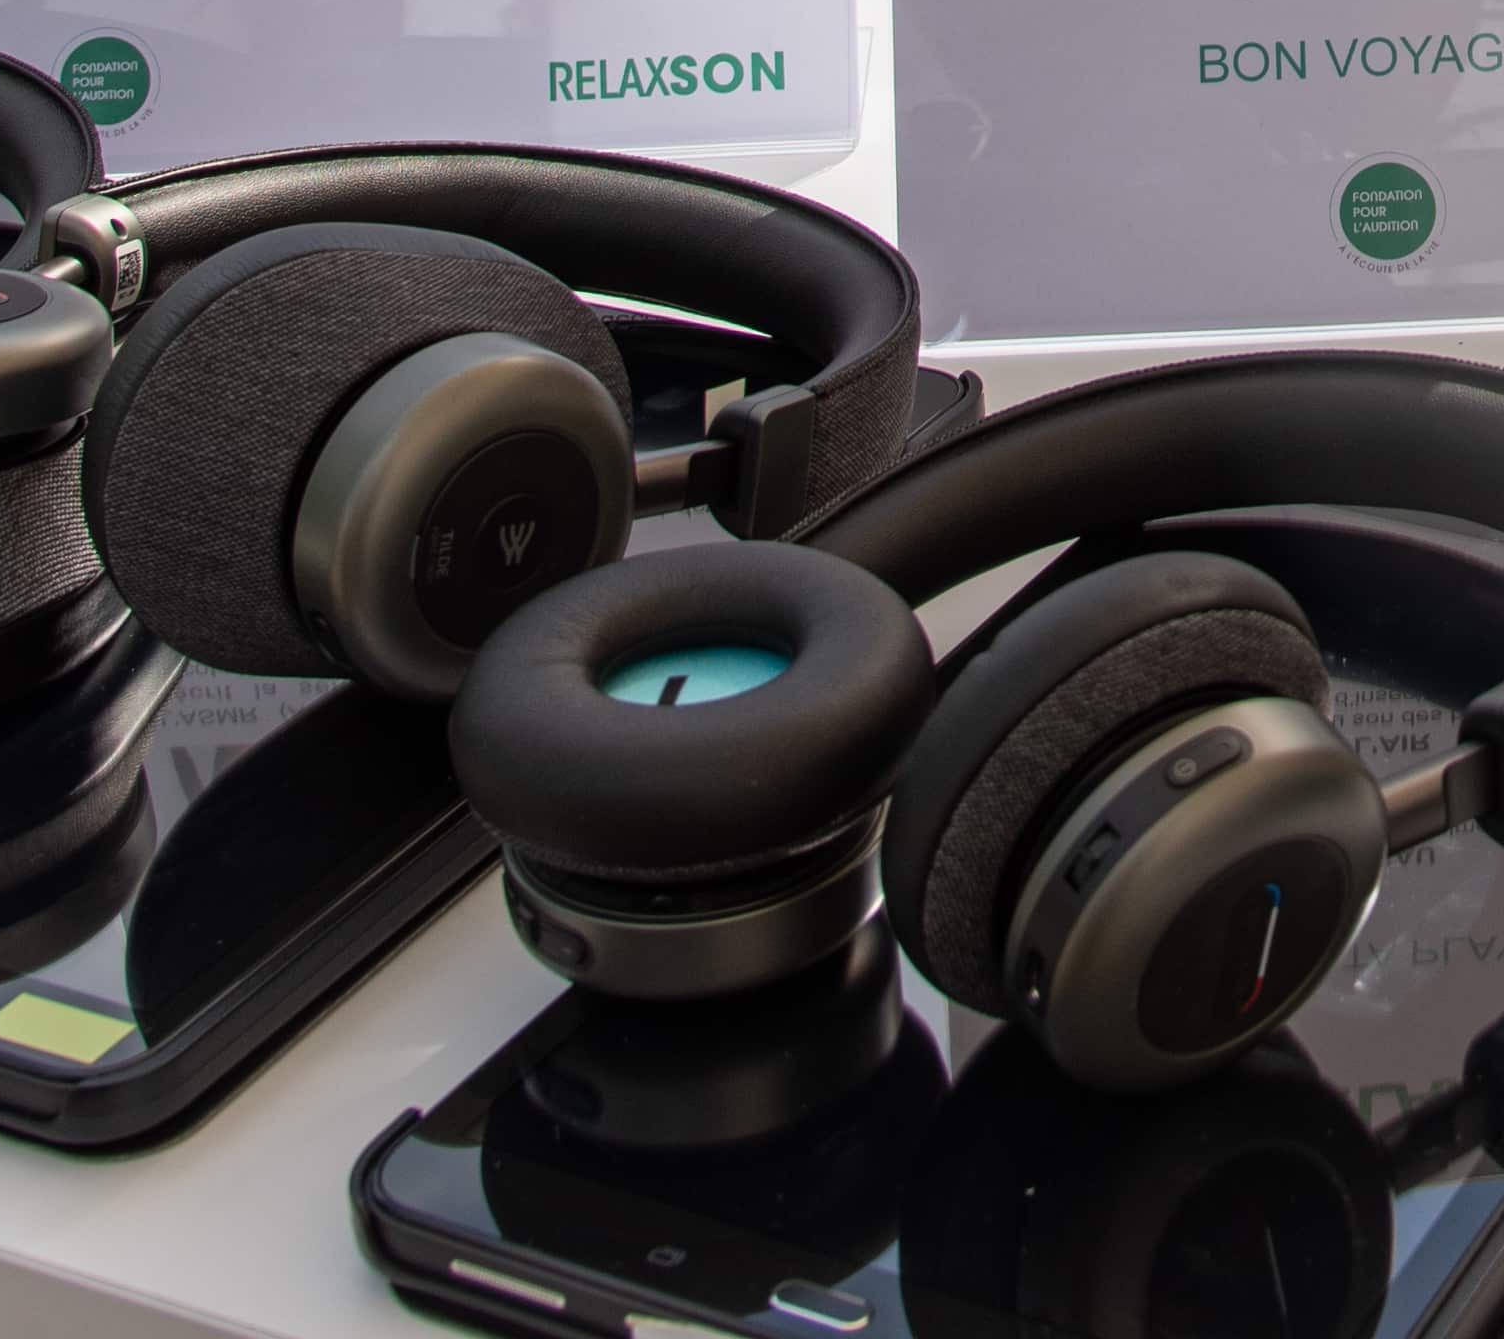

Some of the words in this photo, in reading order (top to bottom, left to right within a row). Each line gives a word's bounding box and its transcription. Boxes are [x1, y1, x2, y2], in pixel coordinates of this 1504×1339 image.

[71, 60, 139, 73] FONDATION
[1199, 40, 1307, 84] BON
[72, 76, 105, 87] POUR
[549, 51, 785, 101] RELAXSON
[73, 89, 134, 101] 'AUDITION
[1352, 189, 1423, 203] FONDATION
[1353, 206, 1387, 218] POUR
[1353, 220, 1419, 234] L'AUDITION
[1397, 261, 1410, 274] DE
[1413, 254, 1426, 266] LA
